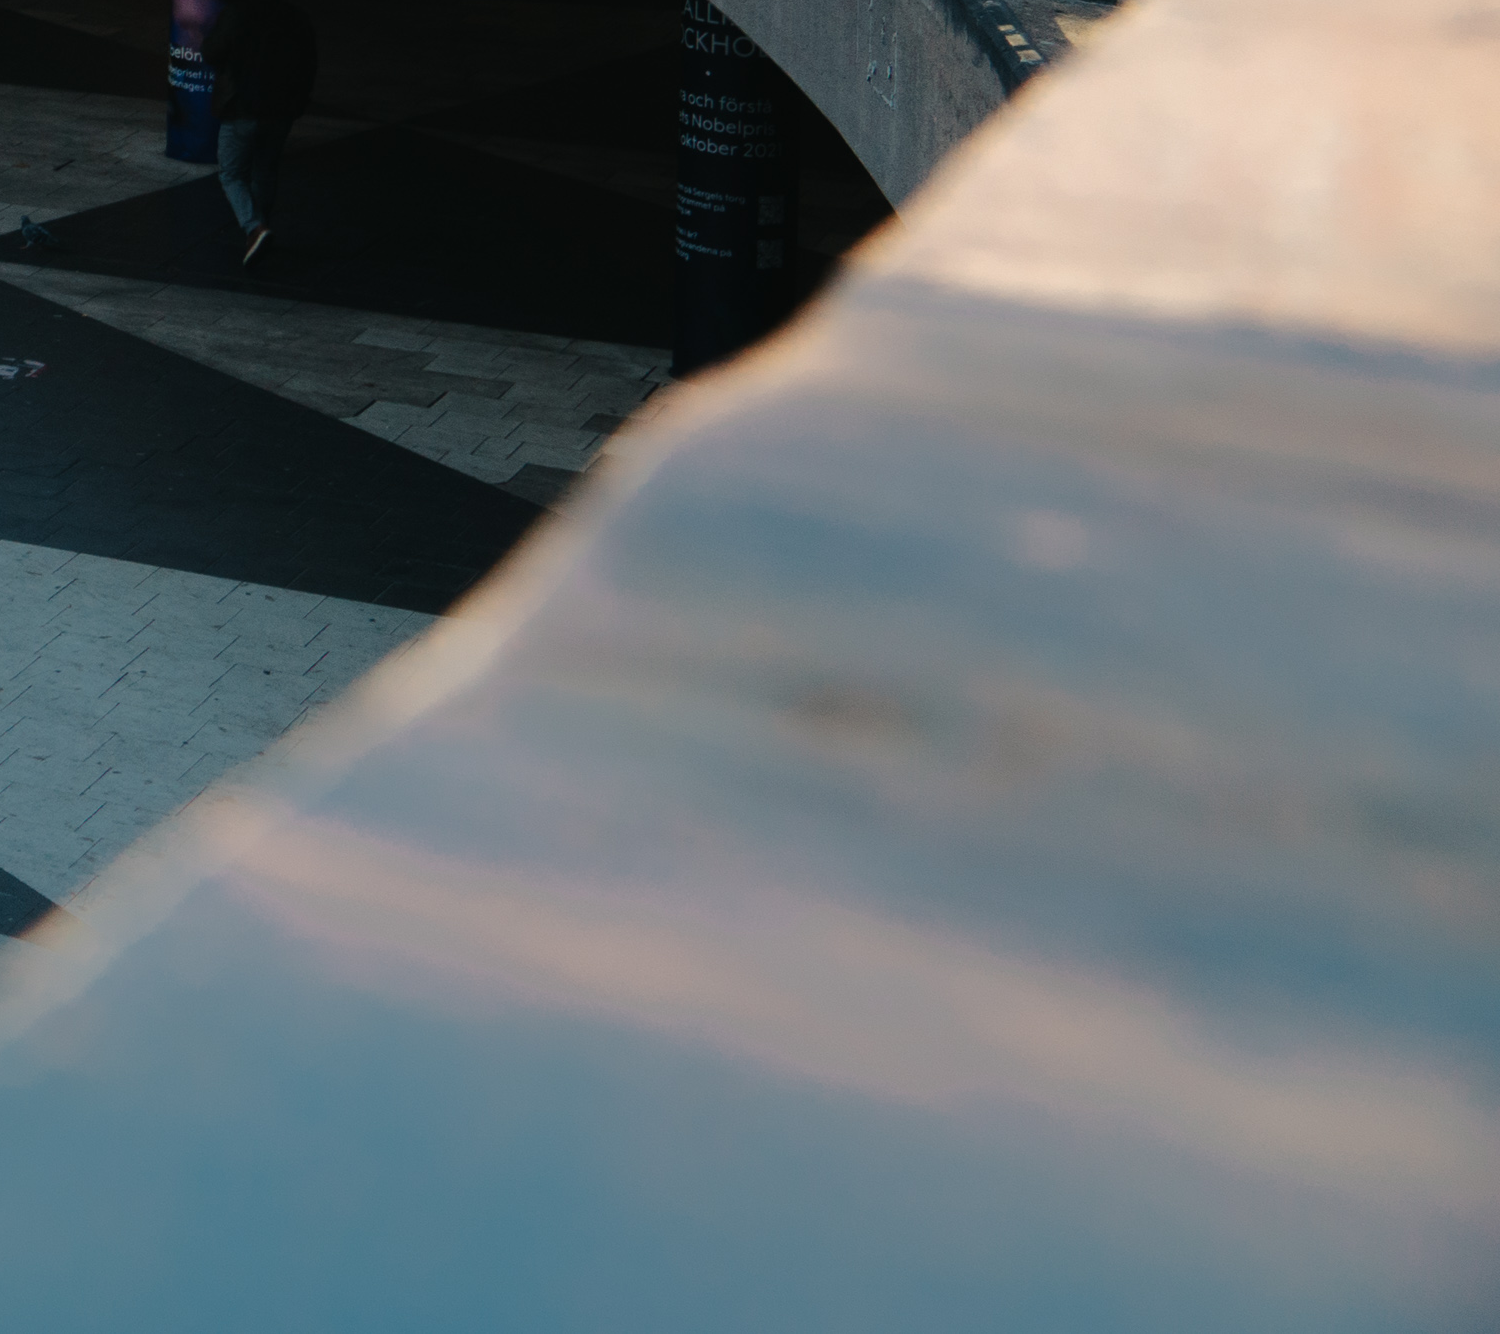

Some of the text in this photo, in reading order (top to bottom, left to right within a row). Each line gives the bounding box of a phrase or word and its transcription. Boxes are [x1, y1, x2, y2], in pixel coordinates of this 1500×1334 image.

[681, 24, 769, 59] CKHO
[687, 93, 714, 110] och
[719, 95, 773, 115] förstå
[691, 112, 776, 139] Nobelpris
[680, 133, 738, 157] oktober
